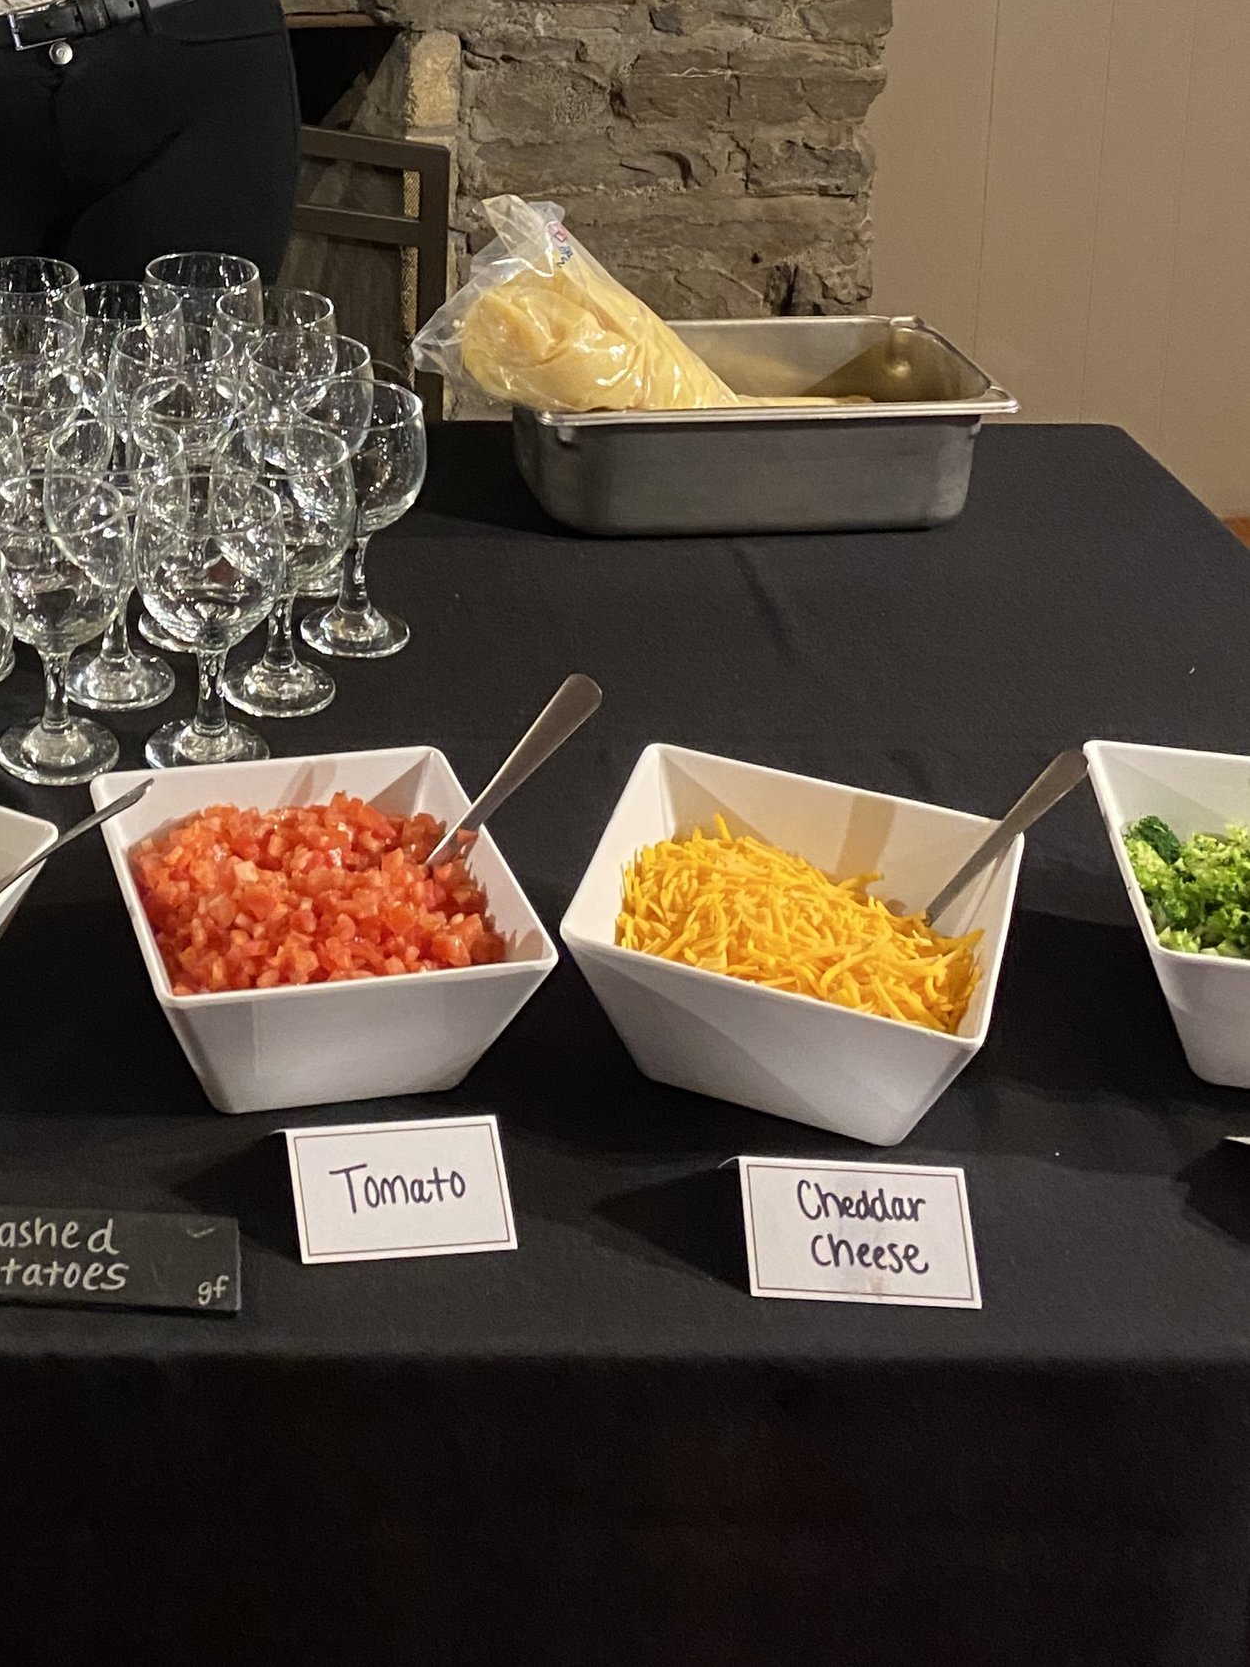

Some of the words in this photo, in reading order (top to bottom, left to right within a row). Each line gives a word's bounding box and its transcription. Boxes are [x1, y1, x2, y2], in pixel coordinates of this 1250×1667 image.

[328, 1163, 467, 1215] Tomato
[796, 1179, 927, 1222] Cheddar
[197, 1275, 230, 1306] gf
